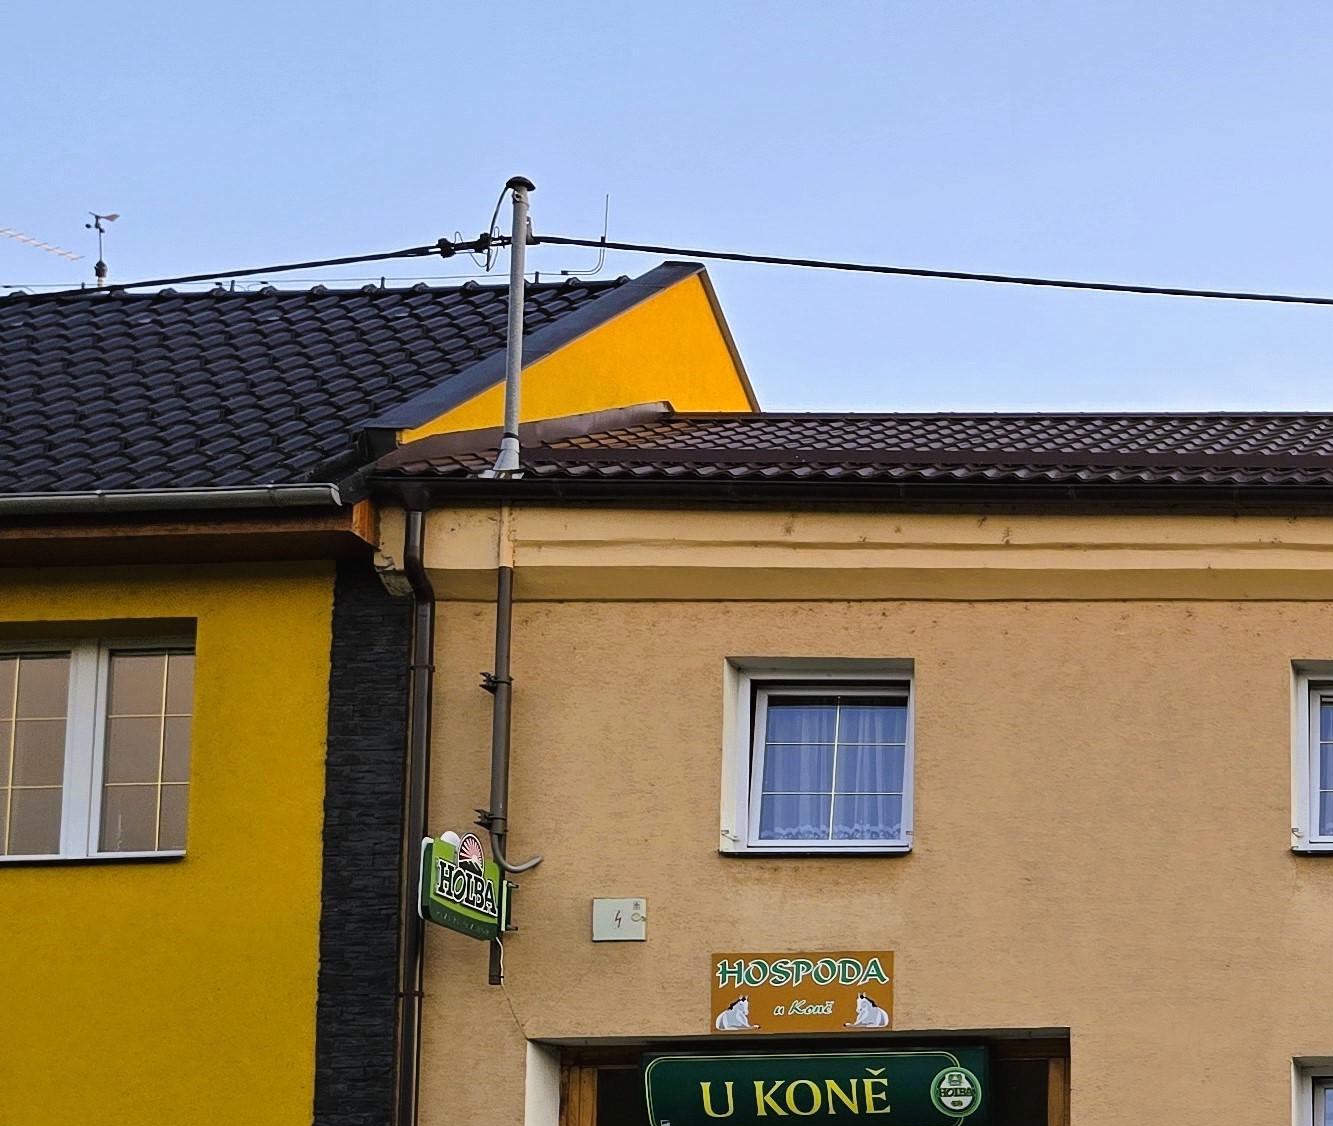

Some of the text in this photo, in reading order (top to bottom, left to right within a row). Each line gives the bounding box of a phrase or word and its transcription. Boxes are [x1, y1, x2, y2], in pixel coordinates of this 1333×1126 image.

[436, 858, 498, 917] HOLBA
[716, 957, 890, 988] HOSPODA
[773, 1000, 835, 1016] u Koně
[700, 1067, 891, 1118] U KONĚ
